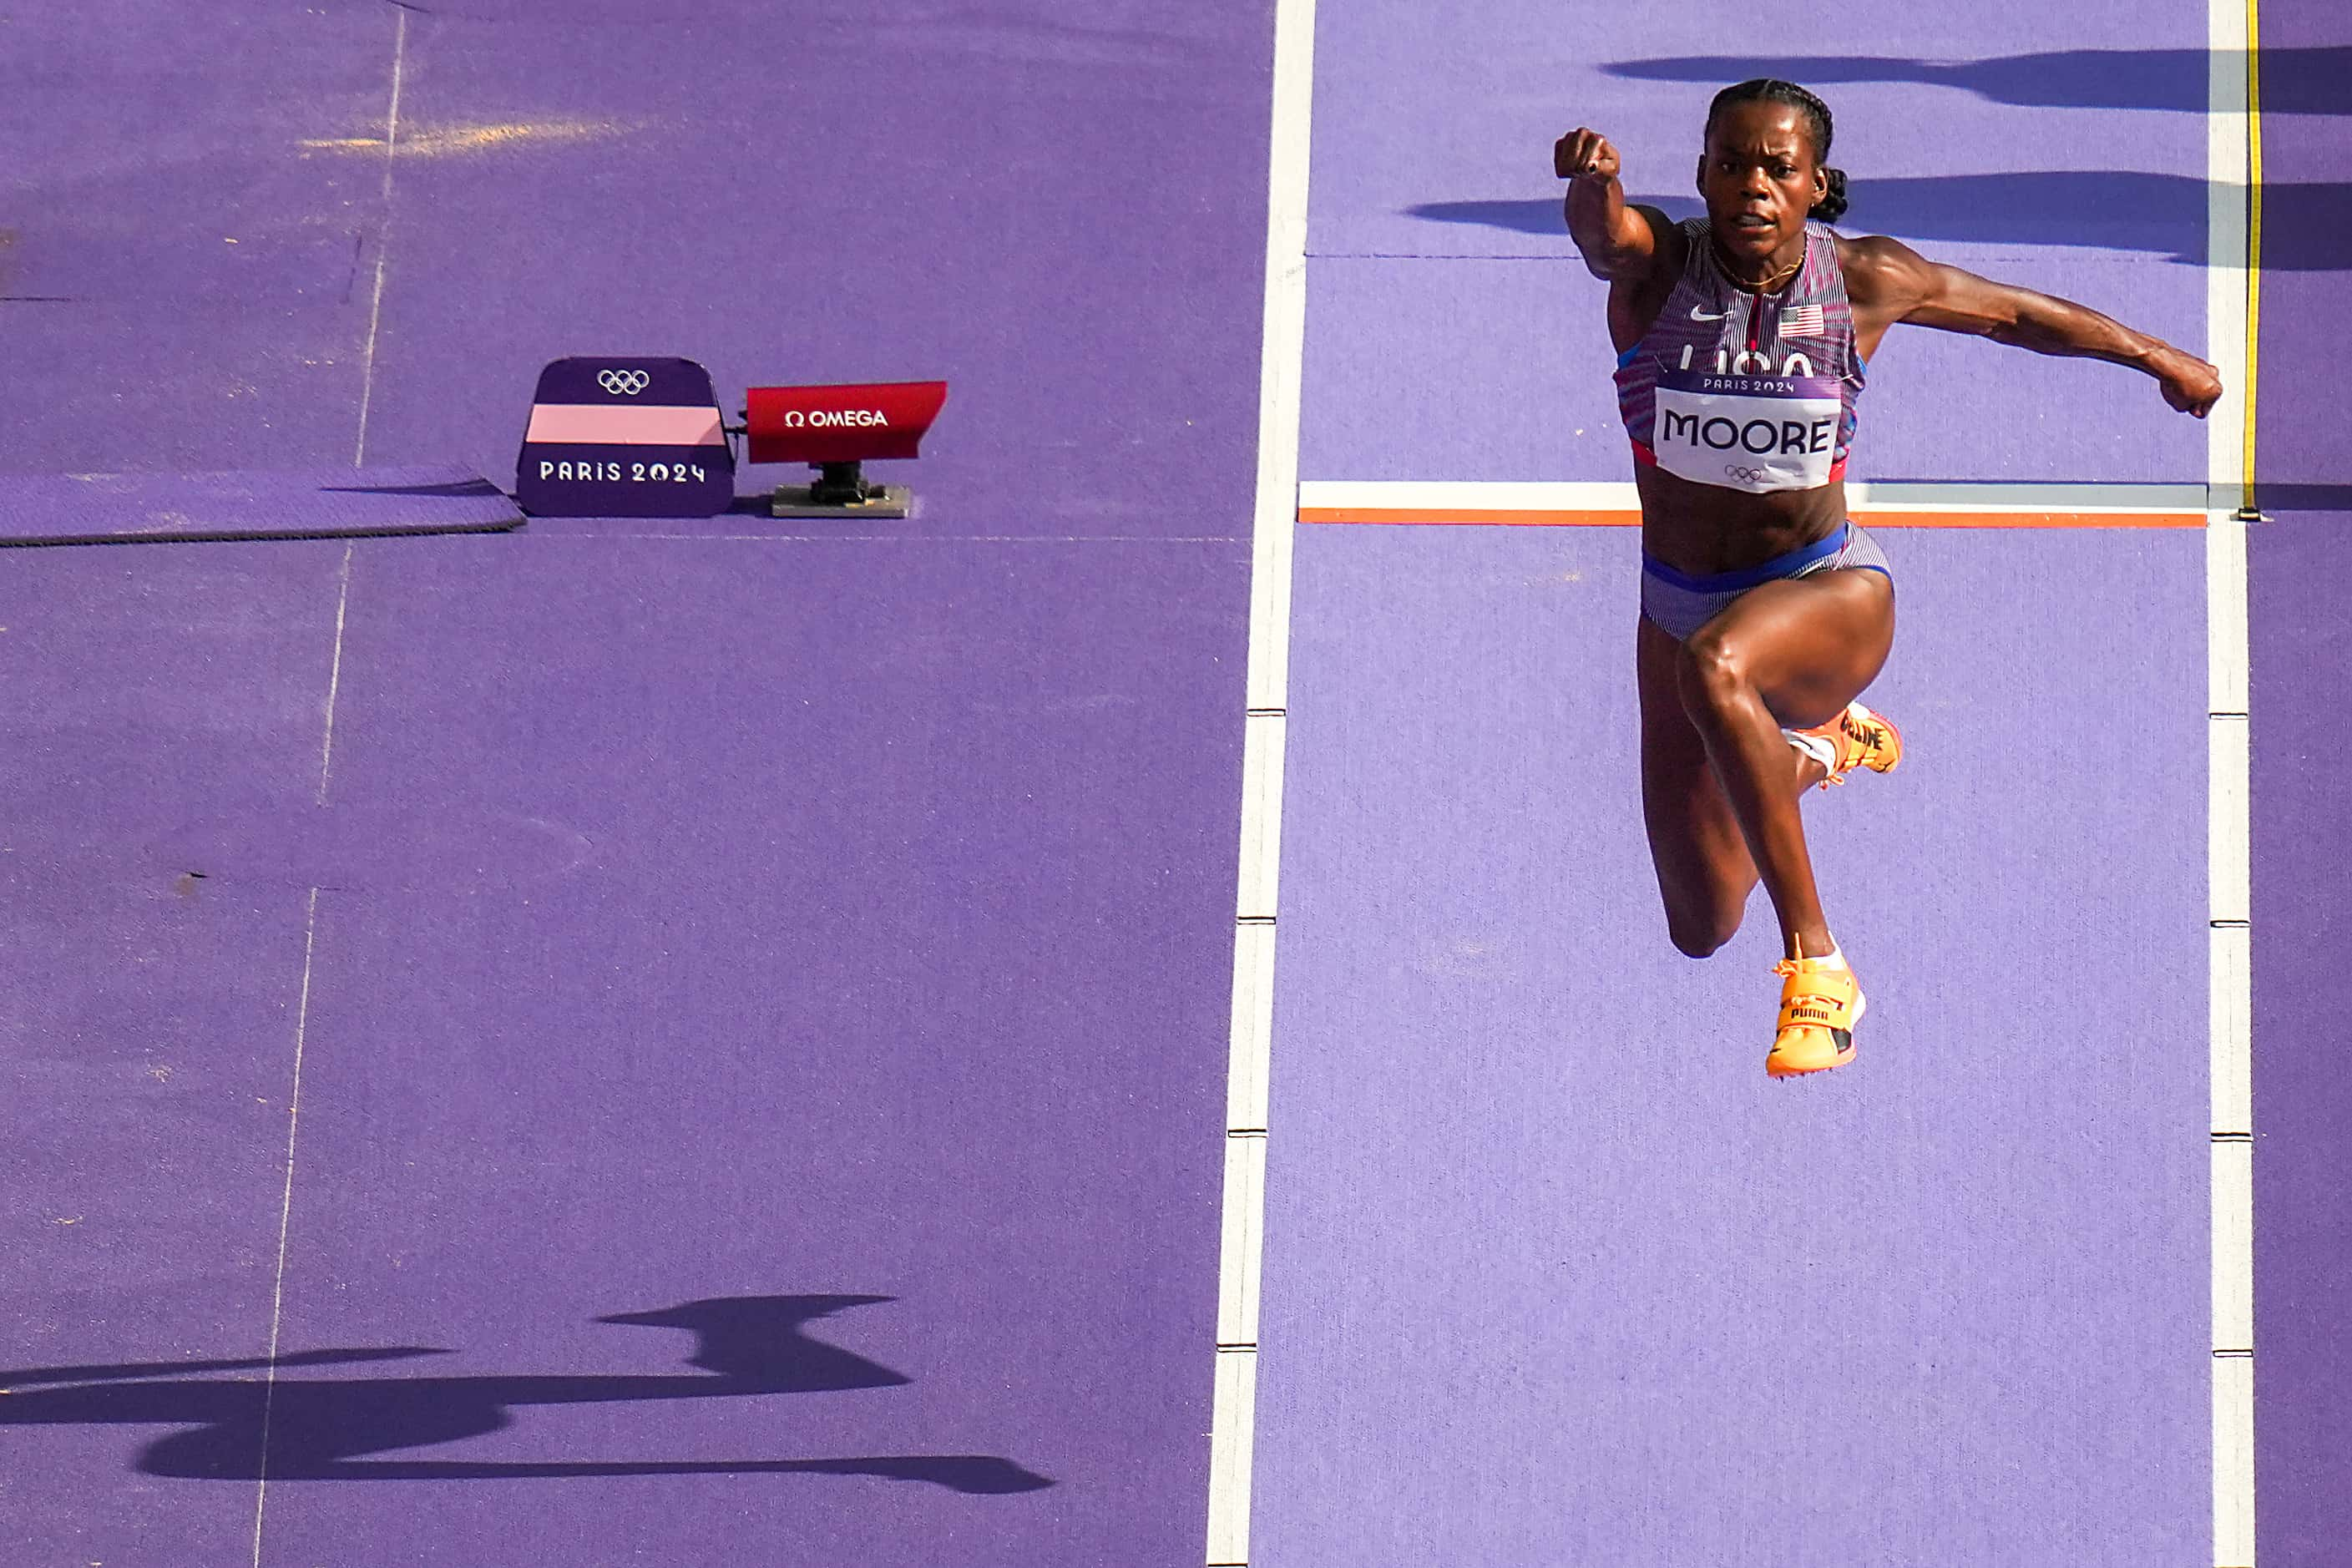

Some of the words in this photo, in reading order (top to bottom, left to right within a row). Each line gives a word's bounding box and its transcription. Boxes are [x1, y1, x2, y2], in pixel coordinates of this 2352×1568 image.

[1703, 378, 1748, 391] PARIS
[1753, 380, 1795, 393] 2024
[808, 409, 889, 427] OMEGA
[1663, 407, 1832, 455] MOORE
[631, 463, 705, 483] 2024
[1790, 1007, 1828, 1020] PUMA
